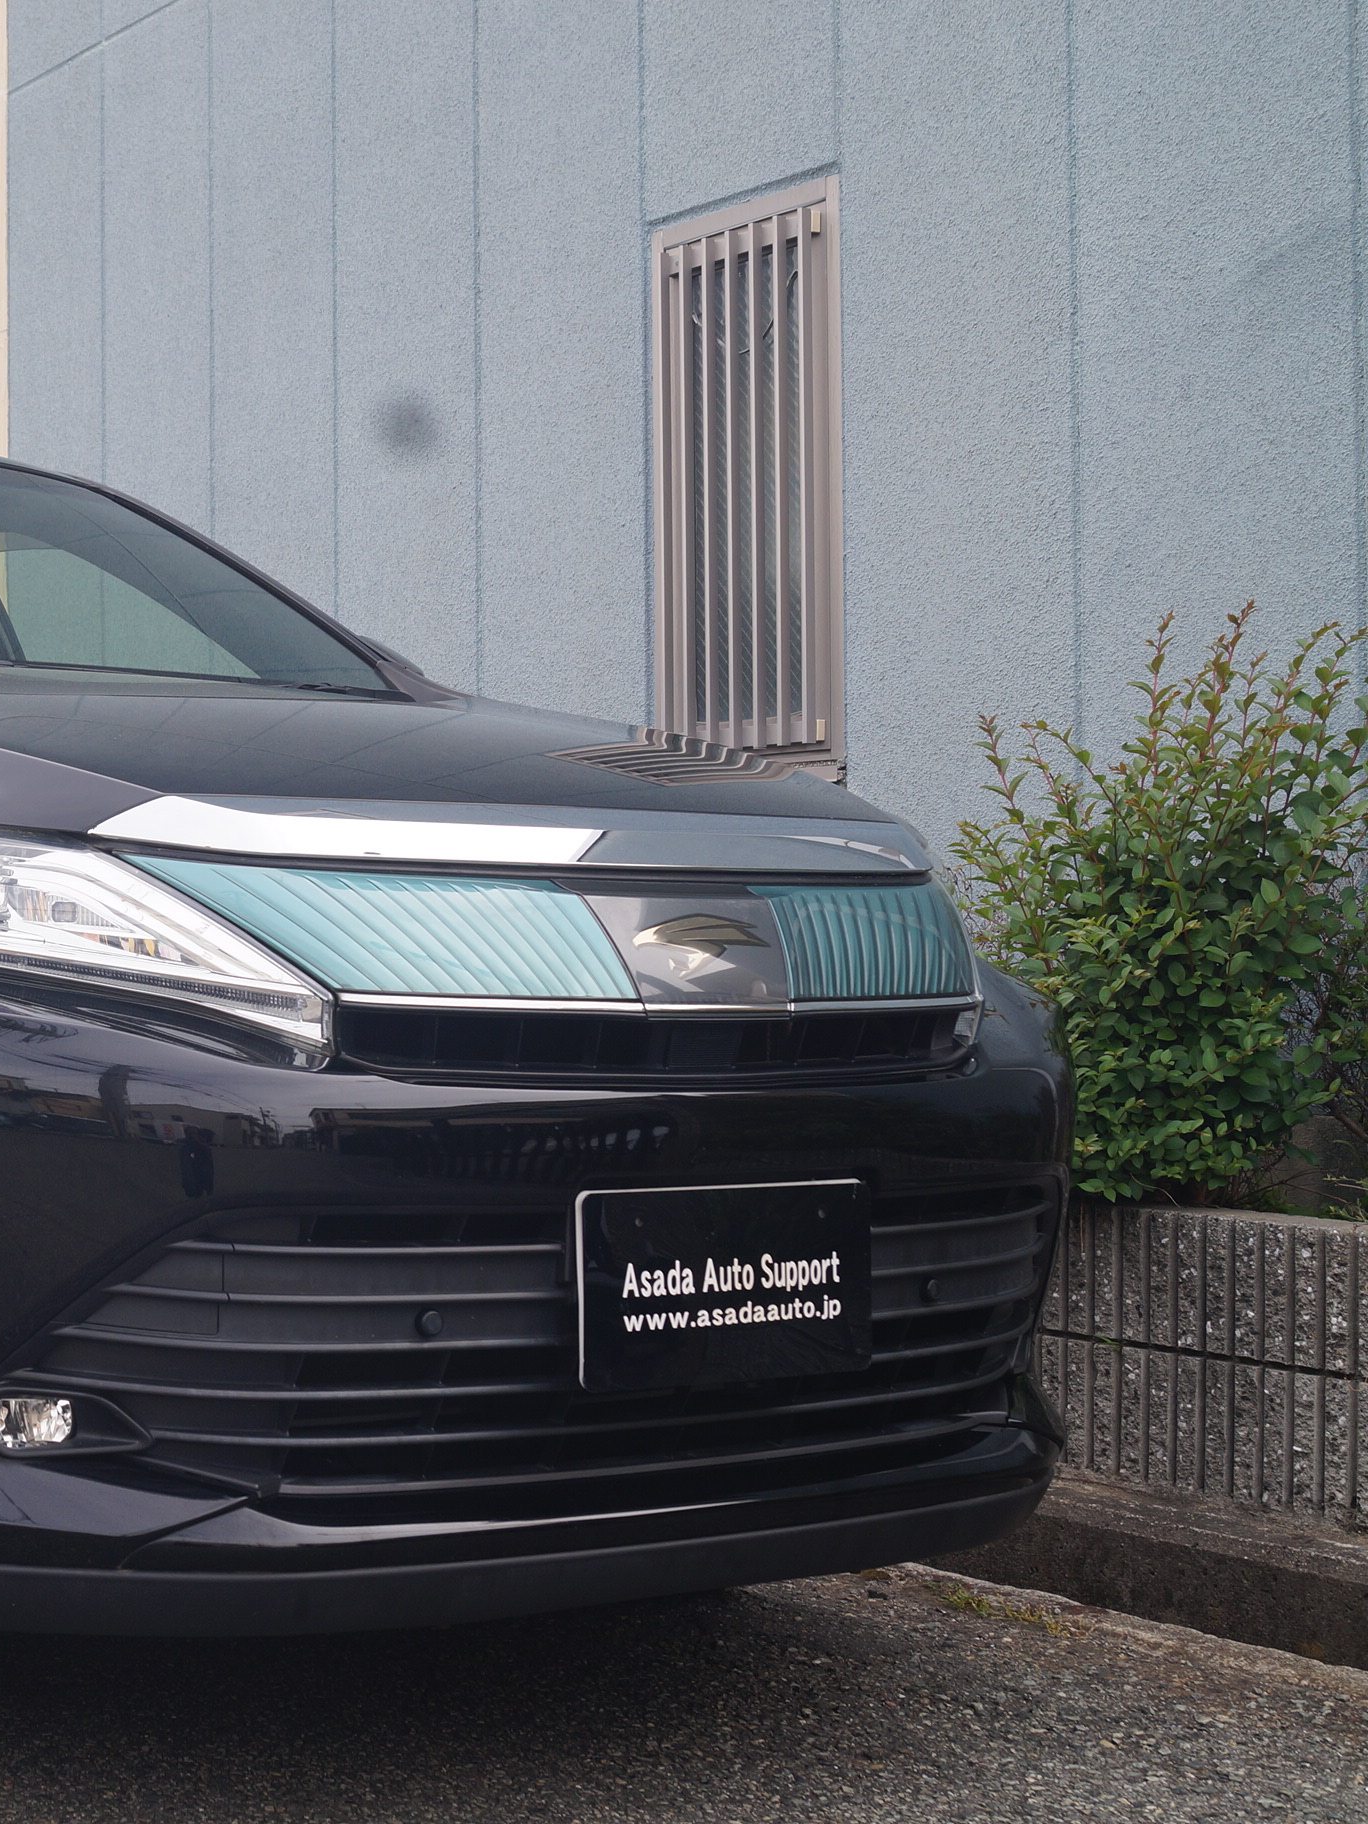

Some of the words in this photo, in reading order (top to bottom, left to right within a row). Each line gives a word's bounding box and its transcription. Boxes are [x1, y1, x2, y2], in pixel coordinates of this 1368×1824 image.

[621, 1260, 696, 1299] Asada
[702, 1257, 755, 1293] Auto
[760, 1250, 841, 1293] Support
[622, 1294, 842, 1333] www.asadaauto.jp
